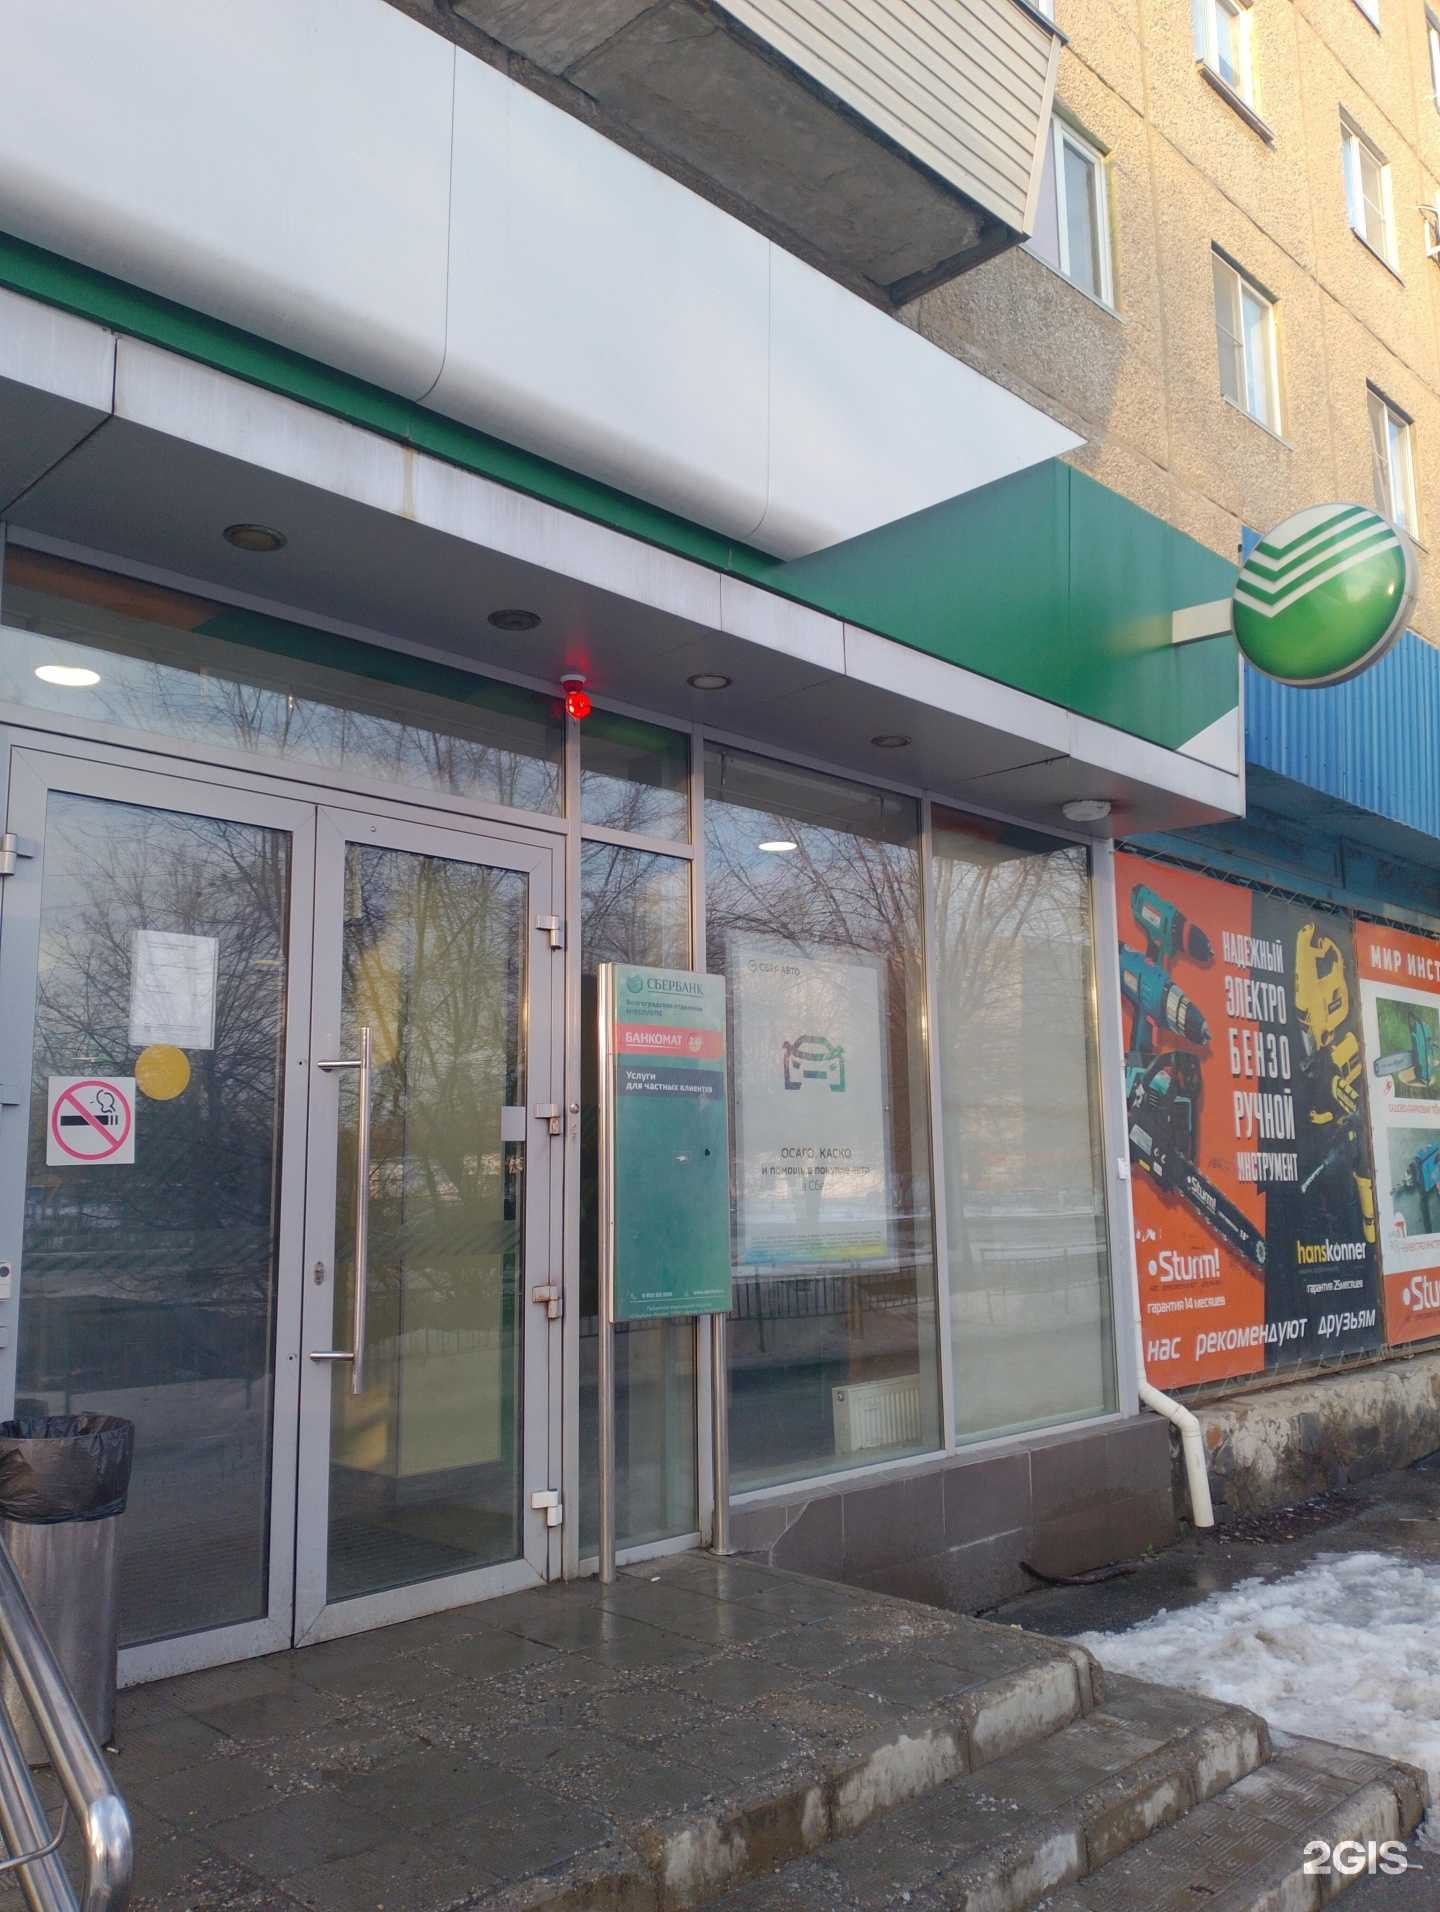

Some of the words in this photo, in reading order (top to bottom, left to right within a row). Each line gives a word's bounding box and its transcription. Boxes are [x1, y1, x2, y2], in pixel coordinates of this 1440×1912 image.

[1222, 929, 1285, 974] НАДЕЖНЫЙ
[1371, 944, 1402, 973] МИР
[647, 978, 704, 995] СБЕРБАНК
[1225, 975, 1287, 1025] ЭЛЕКТРО
[625, 1031, 682, 1046] БАНКОМАТ
[1228, 1027, 1292, 1080] БЕНЗО
[625, 1082, 643, 1091] для
[626, 1071, 656, 1082] Услуги
[1233, 1088, 1296, 1140] РУЧНОЙ
[819, 1148, 852, 1159] КАСКО
[1236, 1151, 1298, 1182] ИНСТРУМЕНТ
[1158, 1249, 1221, 1283] Sturm!
[1147, 1301, 1185, 1316] гарантия
[1147, 1336, 1182, 1362] нас
[1195, 1318, 1308, 1361] рекомендуют
[1317, 1309, 1376, 1339] друзьям
